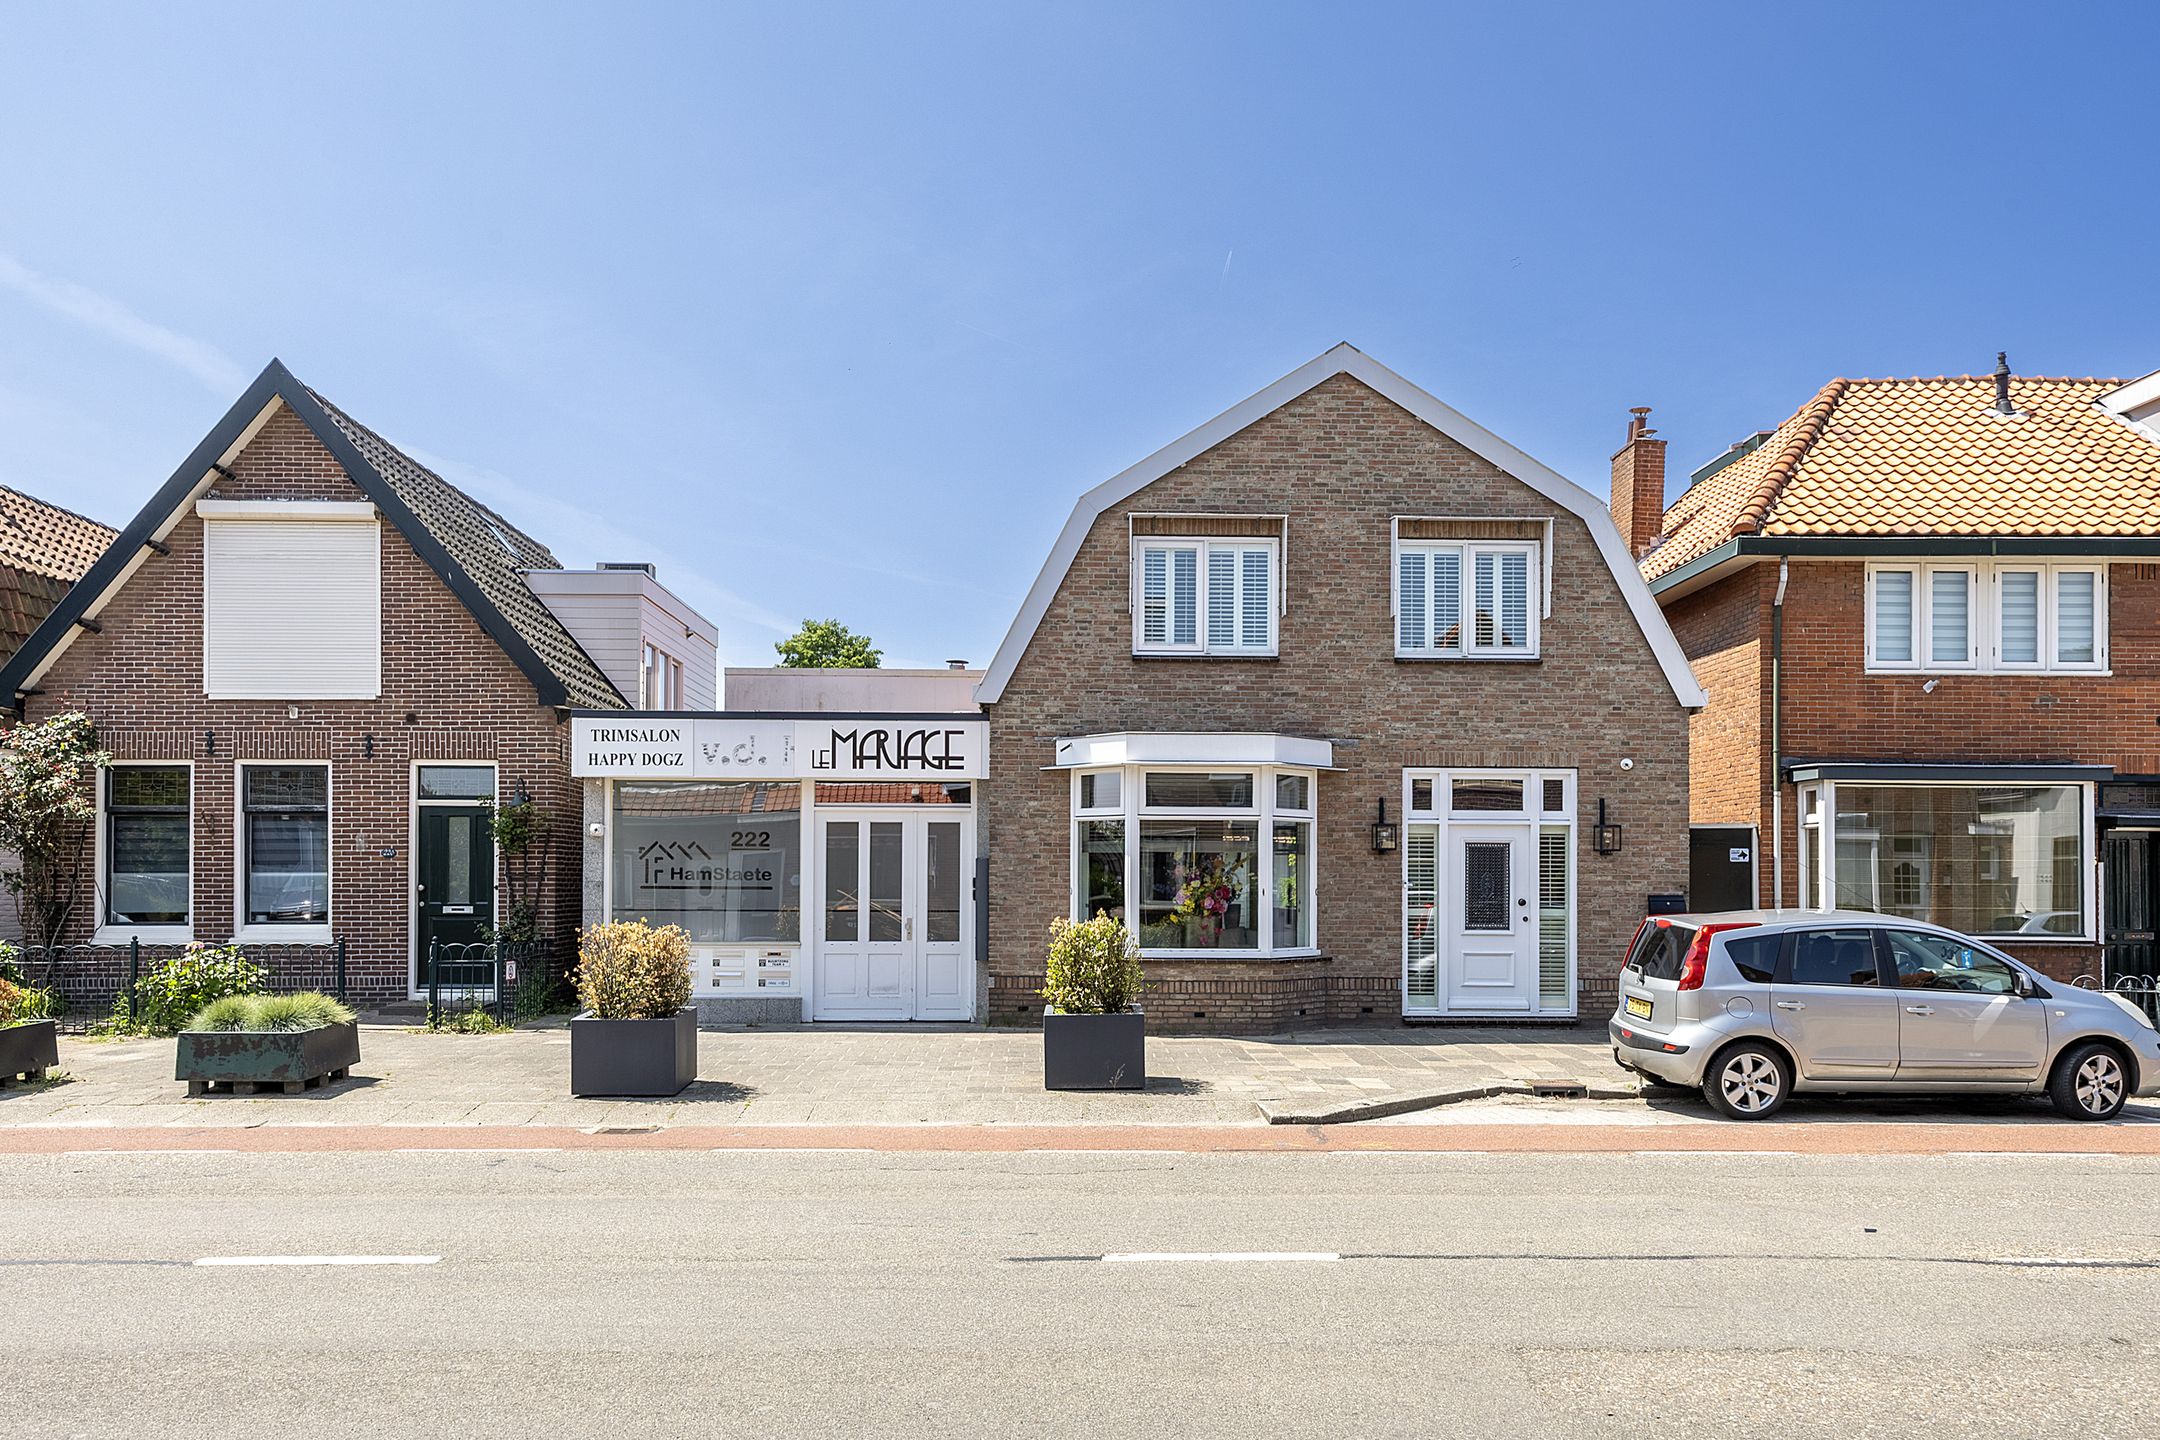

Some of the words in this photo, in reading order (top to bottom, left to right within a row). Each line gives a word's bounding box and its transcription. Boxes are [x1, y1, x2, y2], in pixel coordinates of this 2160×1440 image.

[590, 728, 681, 743] TRIMSALON
[811, 749, 830, 769] LE
[831, 728, 965, 770] MARIAGE
[588, 752, 637, 767] HAPPY
[642, 752, 684, 767] DOGZ
[731, 831, 770, 847] 222
[670, 867, 773, 881] HamStaete
